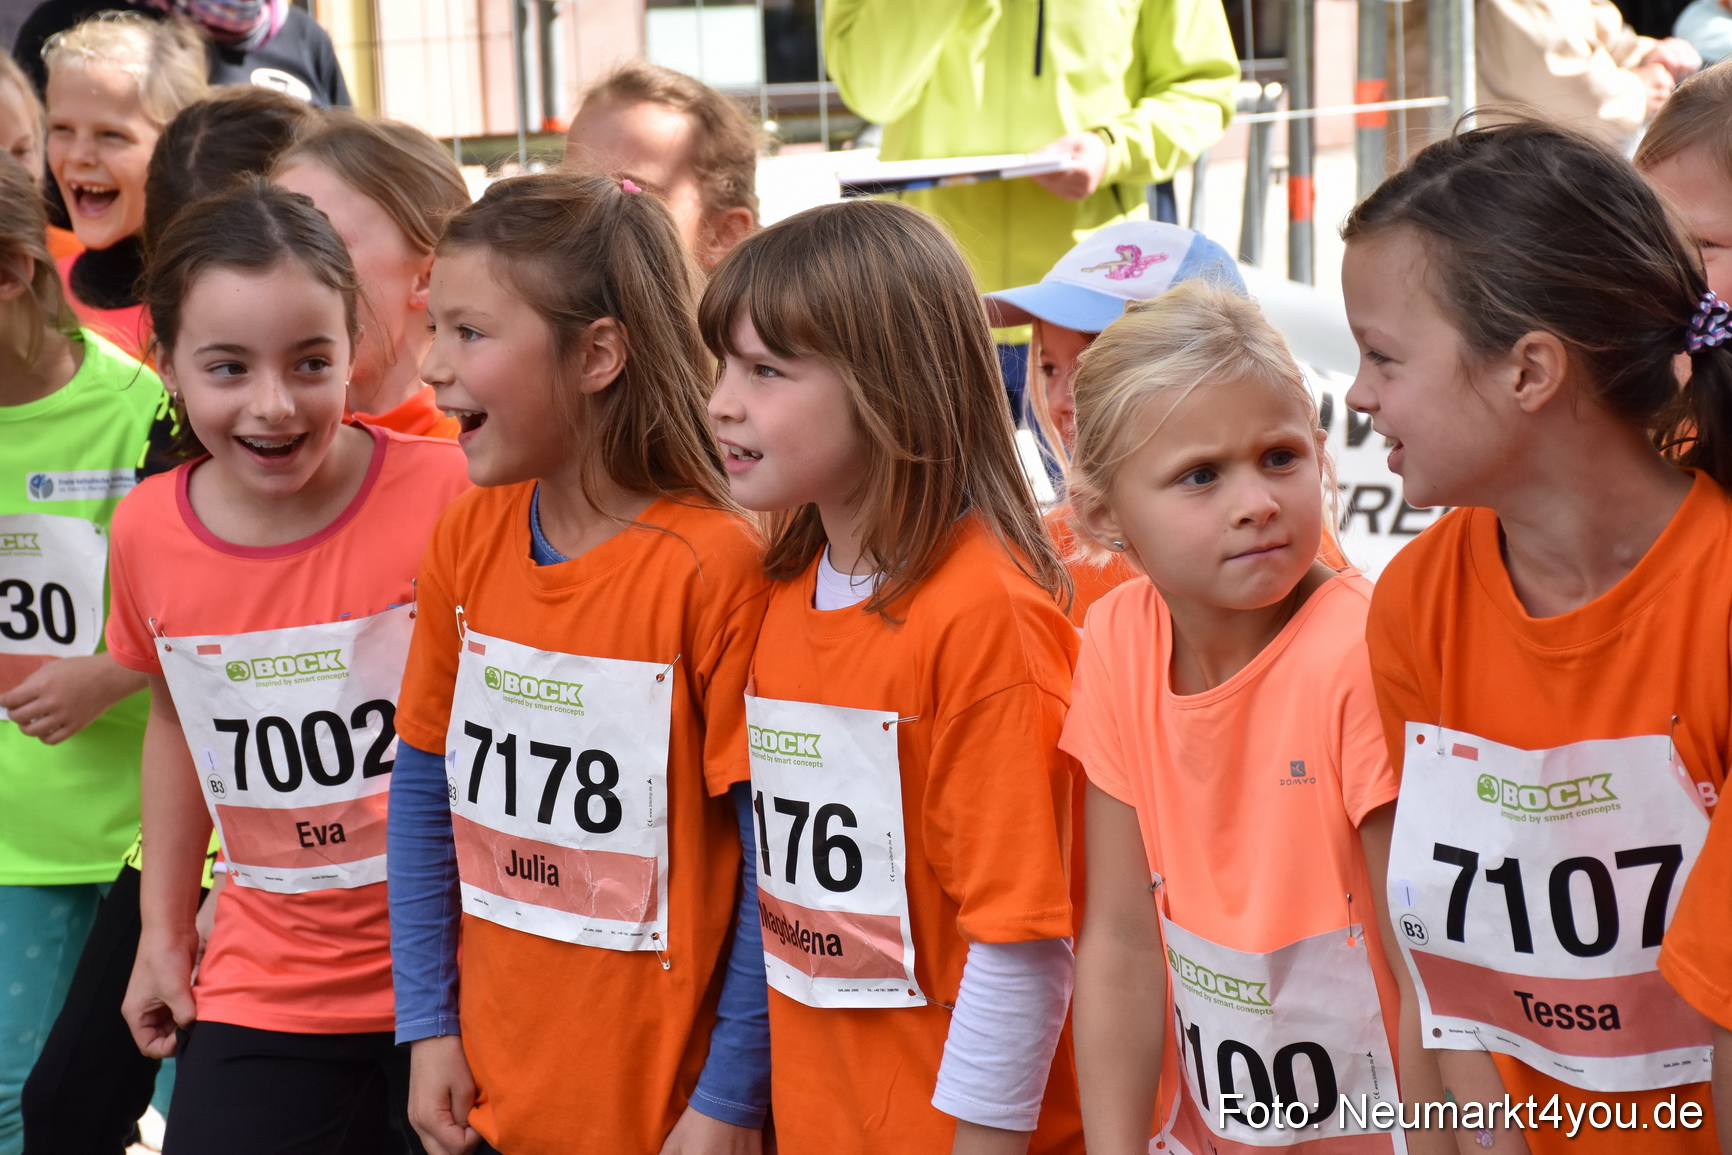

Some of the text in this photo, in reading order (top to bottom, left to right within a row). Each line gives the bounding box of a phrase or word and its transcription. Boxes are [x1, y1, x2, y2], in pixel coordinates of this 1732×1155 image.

[0, 578, 76, 646] 30
[250, 649, 347, 680] BOCK
[255, 671, 350, 688] inspired by smart concepts
[502, 694, 585, 717] inspired by smart concepts
[503, 670, 584, 708] BOCK
[212, 698, 398, 793] 7002
[748, 724, 822, 759] BOCK
[464, 719, 623, 834] 7178
[766, 754, 774, 763] by
[774, 756, 792, 765] smart
[793, 759, 824, 768] concepts
[211, 780, 225, 795] B3
[1279, 777, 1317, 786] DOMYO
[1501, 773, 1619, 813] BOCK
[1500, 803, 1622, 824] inspired by smart concepts
[296, 821, 346, 848] Eva
[505, 849, 560, 888] Julia
[1433, 842, 1684, 958] 7107
[758, 899, 844, 957] Magdalena
[1403, 921, 1425, 940] B3
[1179, 954, 1272, 1007] BOCK
[1181, 982, 1274, 1016] inspired by smart concepts
[1514, 990, 1622, 1031] Tessa
